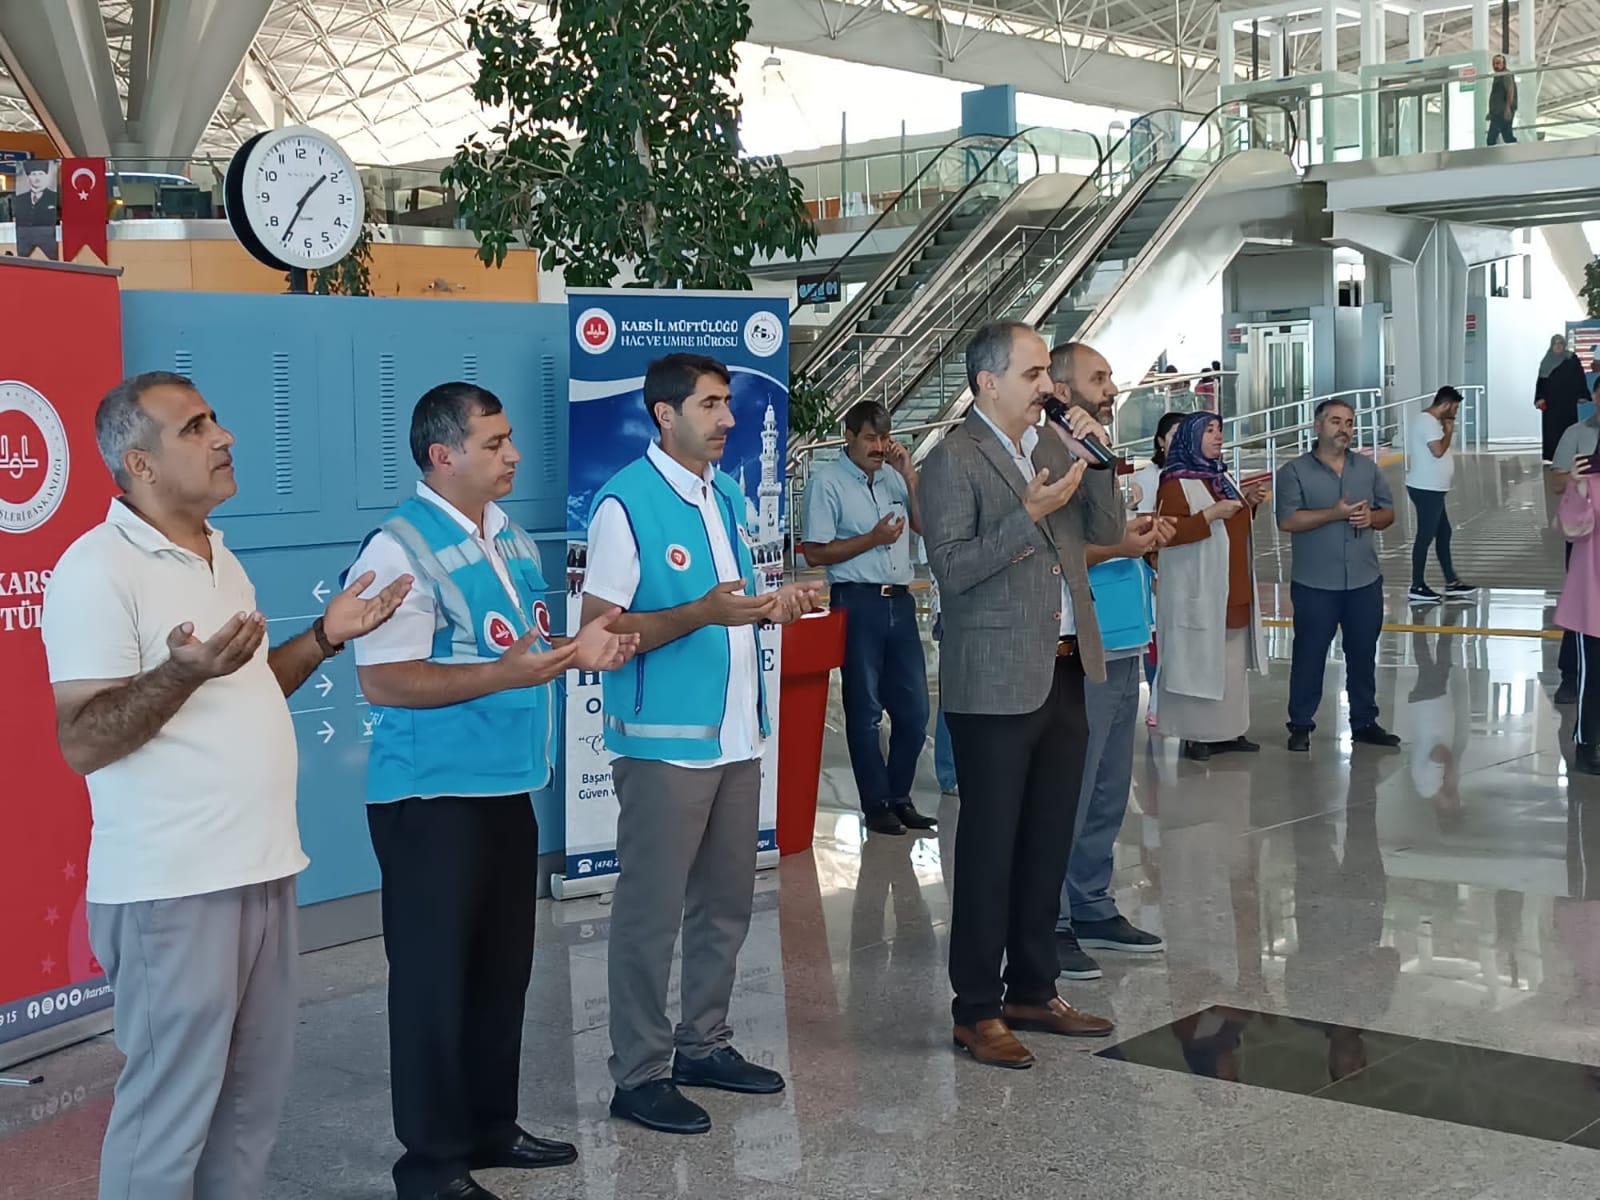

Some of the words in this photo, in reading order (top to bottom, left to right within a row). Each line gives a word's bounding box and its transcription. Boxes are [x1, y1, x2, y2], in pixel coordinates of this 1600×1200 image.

[278, 153, 285, 165] 11
[295, 148, 307, 159] 12
[265, 170, 278, 182] 10
[330, 172, 339, 183] 2
[260, 192, 270, 203] 9
[337, 194, 345, 205] 3
[269, 216, 279, 227] 8
[333, 217, 342, 227] 4
[320, 232, 330, 243] 5
[303, 238, 313, 249] 6
[621, 320, 653, 332] KARS
[654, 318, 666, 332] İL
[621, 335, 645, 346] HAC
[646, 336, 661, 347] VE
[663, 336, 695, 347] UMRE
[697, 334, 738, 347] BÜROSU
[578, 788, 609, 800] Güven
